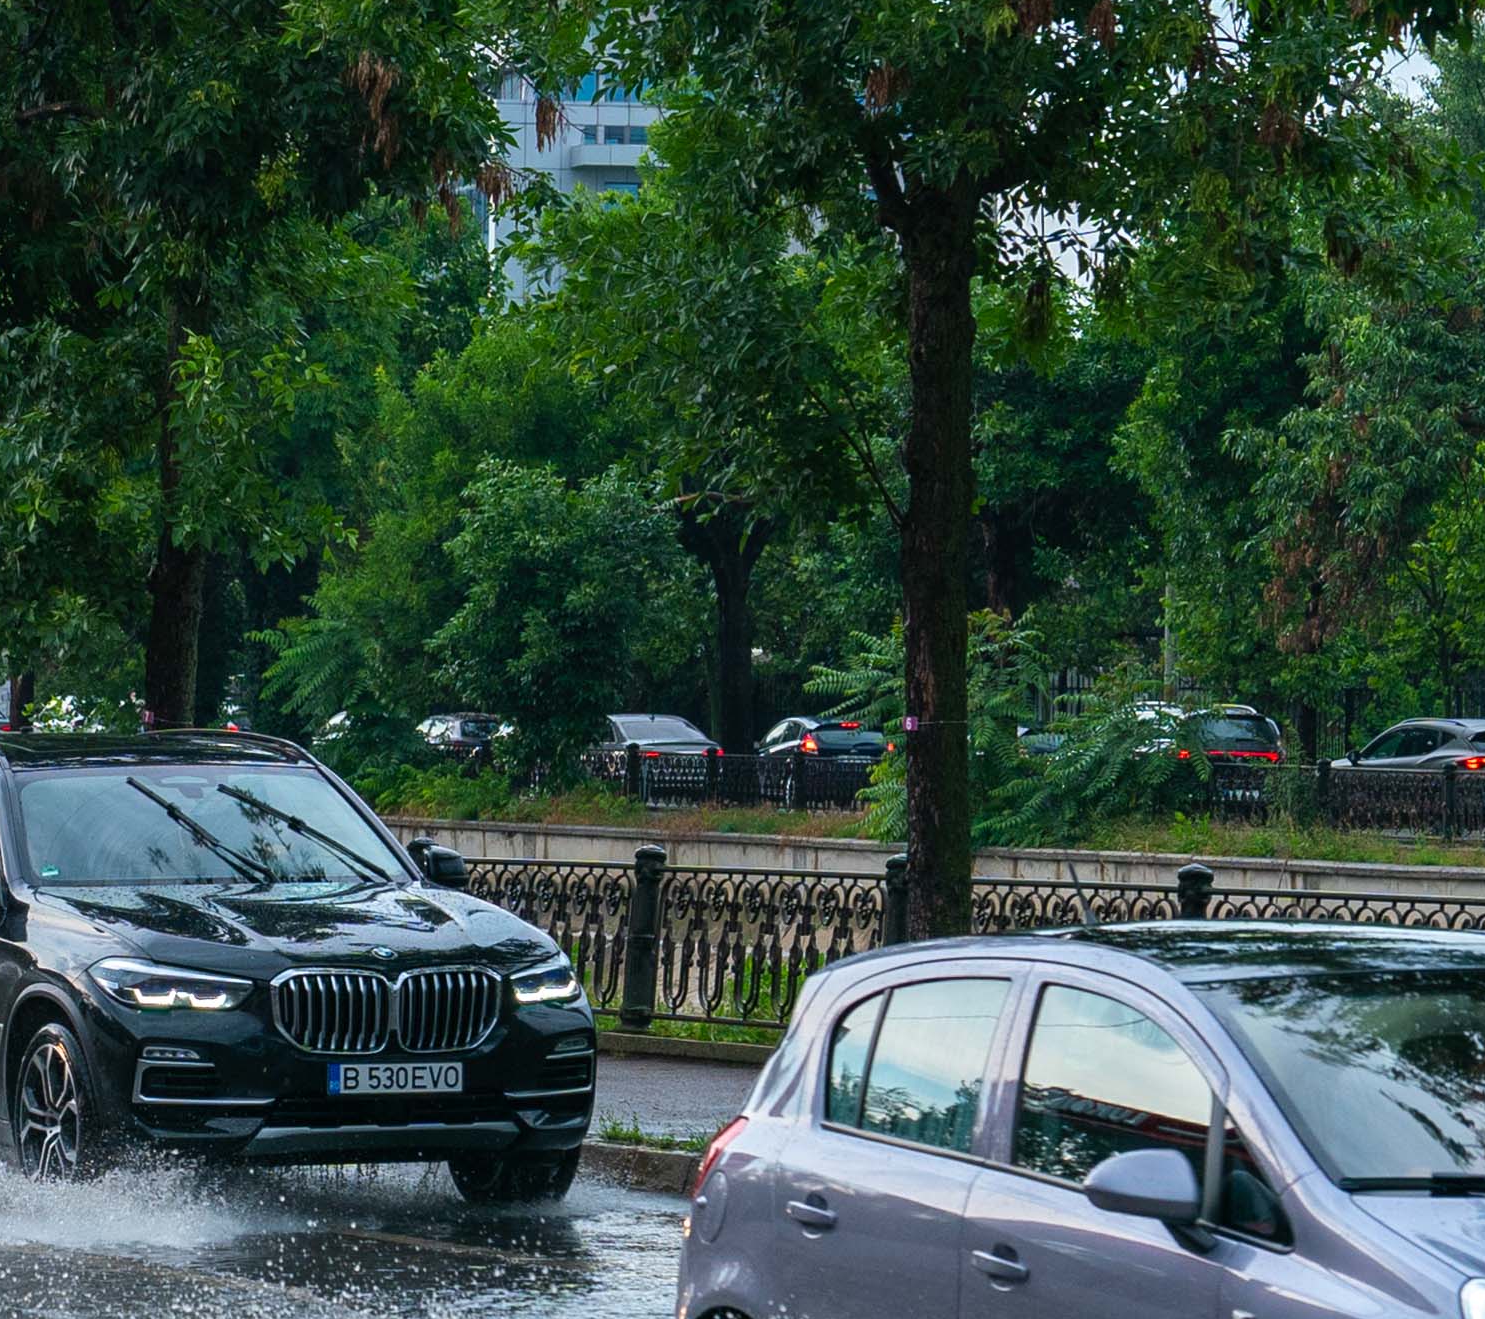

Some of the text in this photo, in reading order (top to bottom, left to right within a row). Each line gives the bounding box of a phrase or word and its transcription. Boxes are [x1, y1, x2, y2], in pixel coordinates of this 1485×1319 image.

[906, 717, 912, 730] 6
[343, 1065, 459, 1090] B 530 EVO
